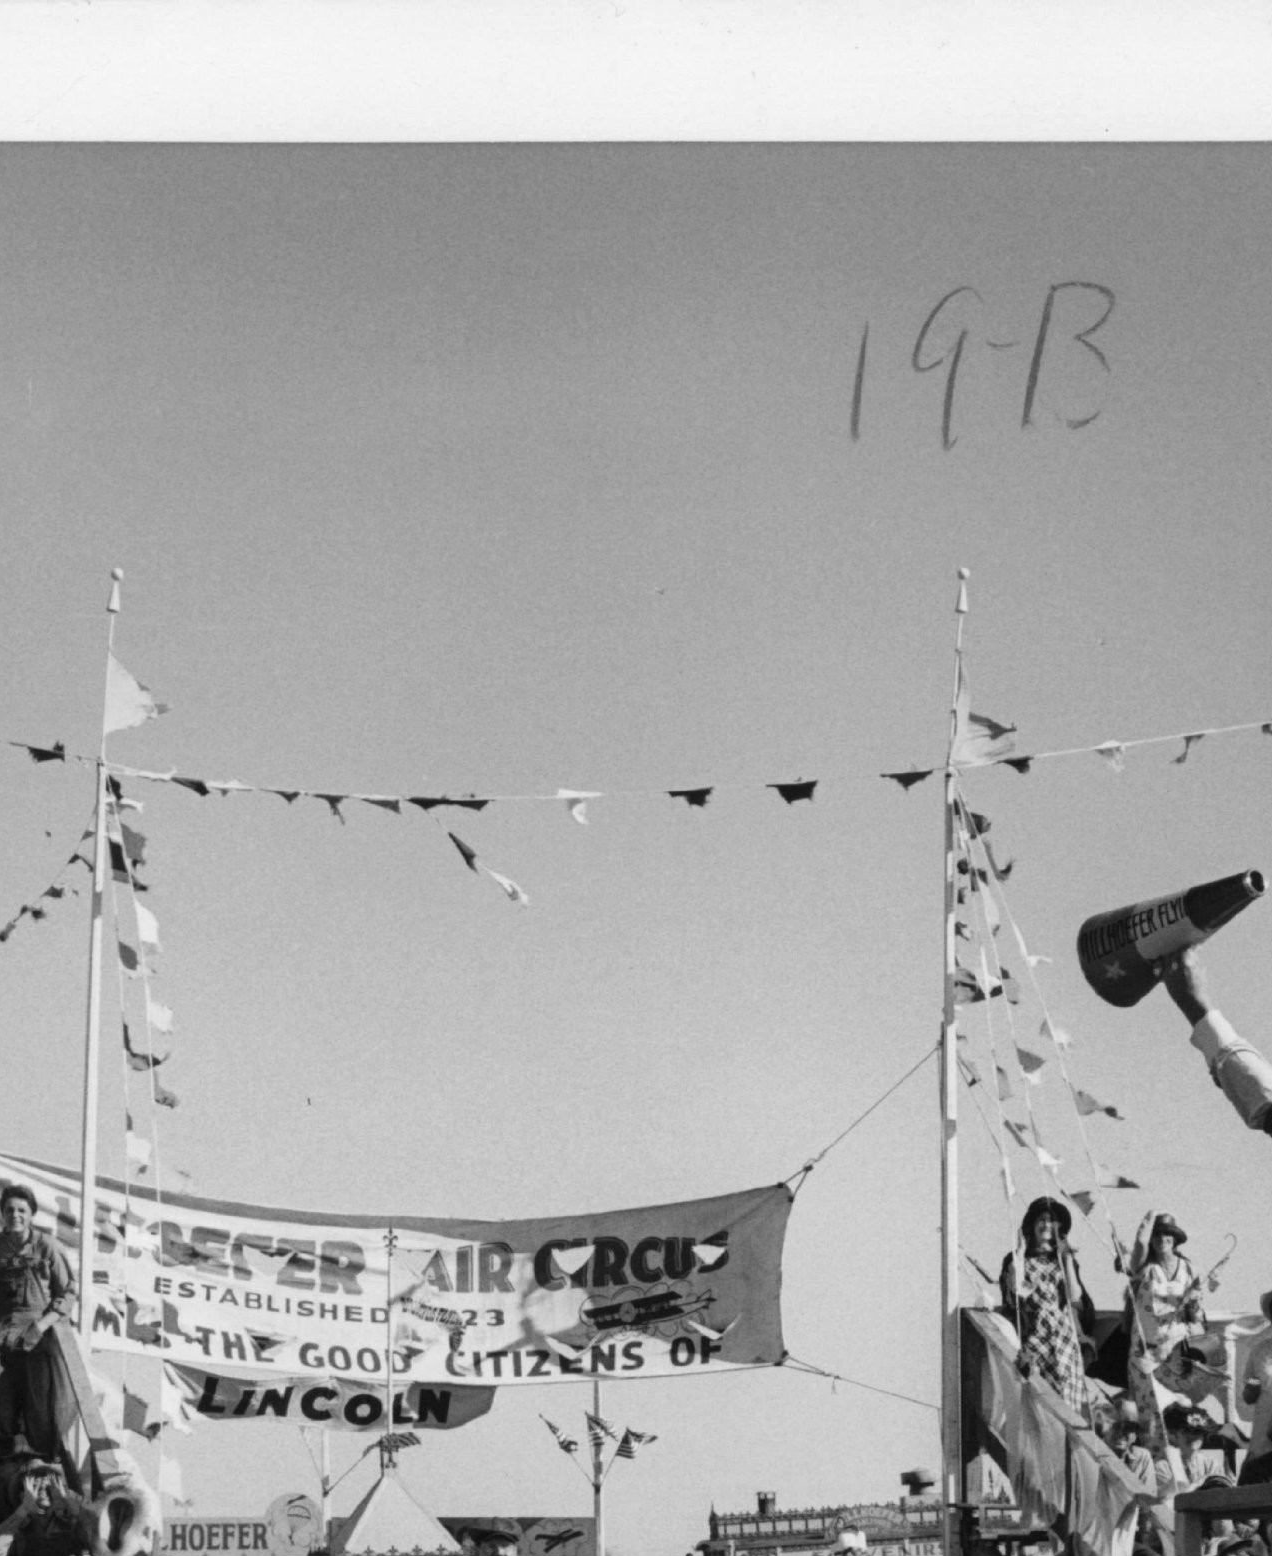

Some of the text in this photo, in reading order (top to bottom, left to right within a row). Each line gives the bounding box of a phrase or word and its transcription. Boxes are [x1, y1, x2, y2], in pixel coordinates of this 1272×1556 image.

[850, 281, 1116, 449] 19-B
[423, 1242, 515, 1293] AIR
[534, 1231, 729, 1291] CIRCUS
[154, 1275, 389, 1324] ESTABLISHED
[298, 1341, 413, 1374] GOOD
[445, 1341, 645, 1377] CITIZENS
[669, 1336, 723, 1369] OF
[196, 1376, 452, 1425] LINCOLN
[162, 1522, 269, 1551] HOEFER
